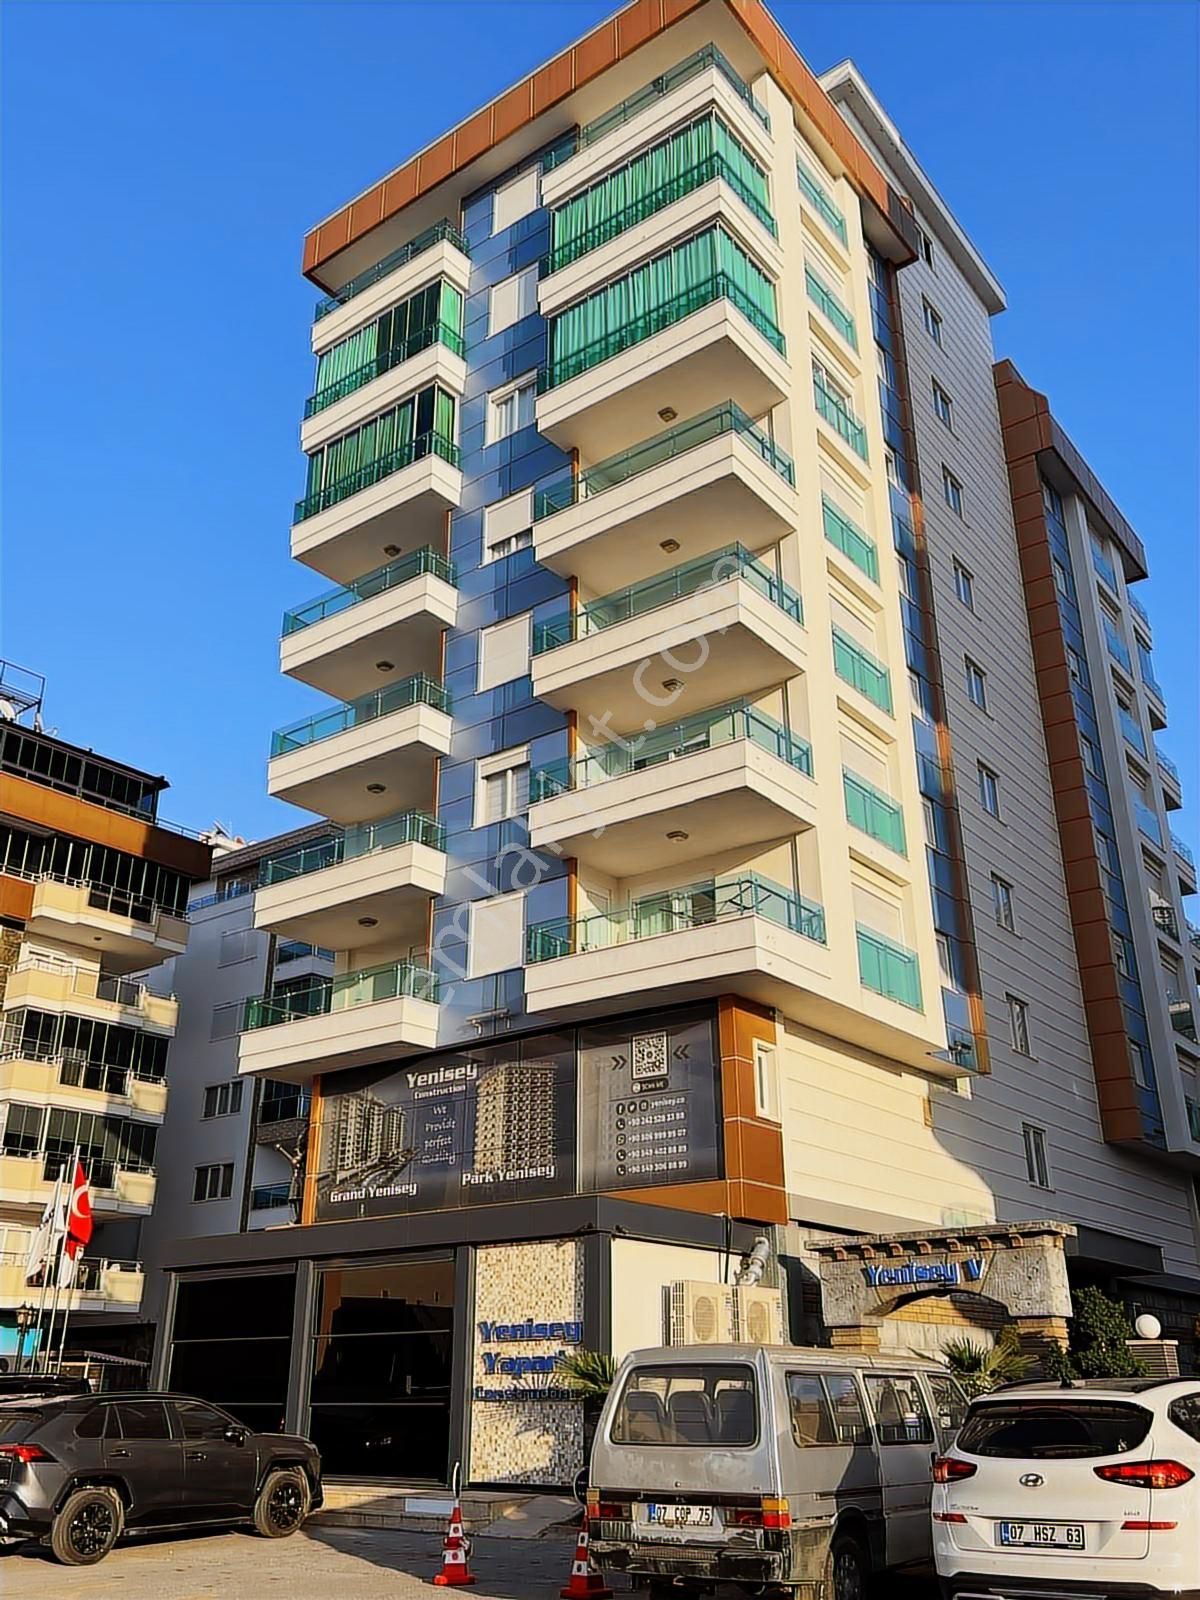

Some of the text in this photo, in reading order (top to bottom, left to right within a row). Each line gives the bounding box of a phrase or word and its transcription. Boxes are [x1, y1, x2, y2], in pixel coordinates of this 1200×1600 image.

[406, 1063, 478, 1089] Yenisey
[414, 1084, 466, 1100] Construction
[462, 1164, 555, 1186] Park Yenisey
[330, 1182, 418, 1202] Grand Yenisey
[861, 1257, 986, 1288] Yenisey V
[478, 1318, 583, 1345] Yenisey
[482, 1350, 567, 1379] Yapar
[657, 1506, 667, 1521] 07
[699, 1508, 710, 1521] 75
[1010, 1525, 1081, 1543] 07 HSZ 63
